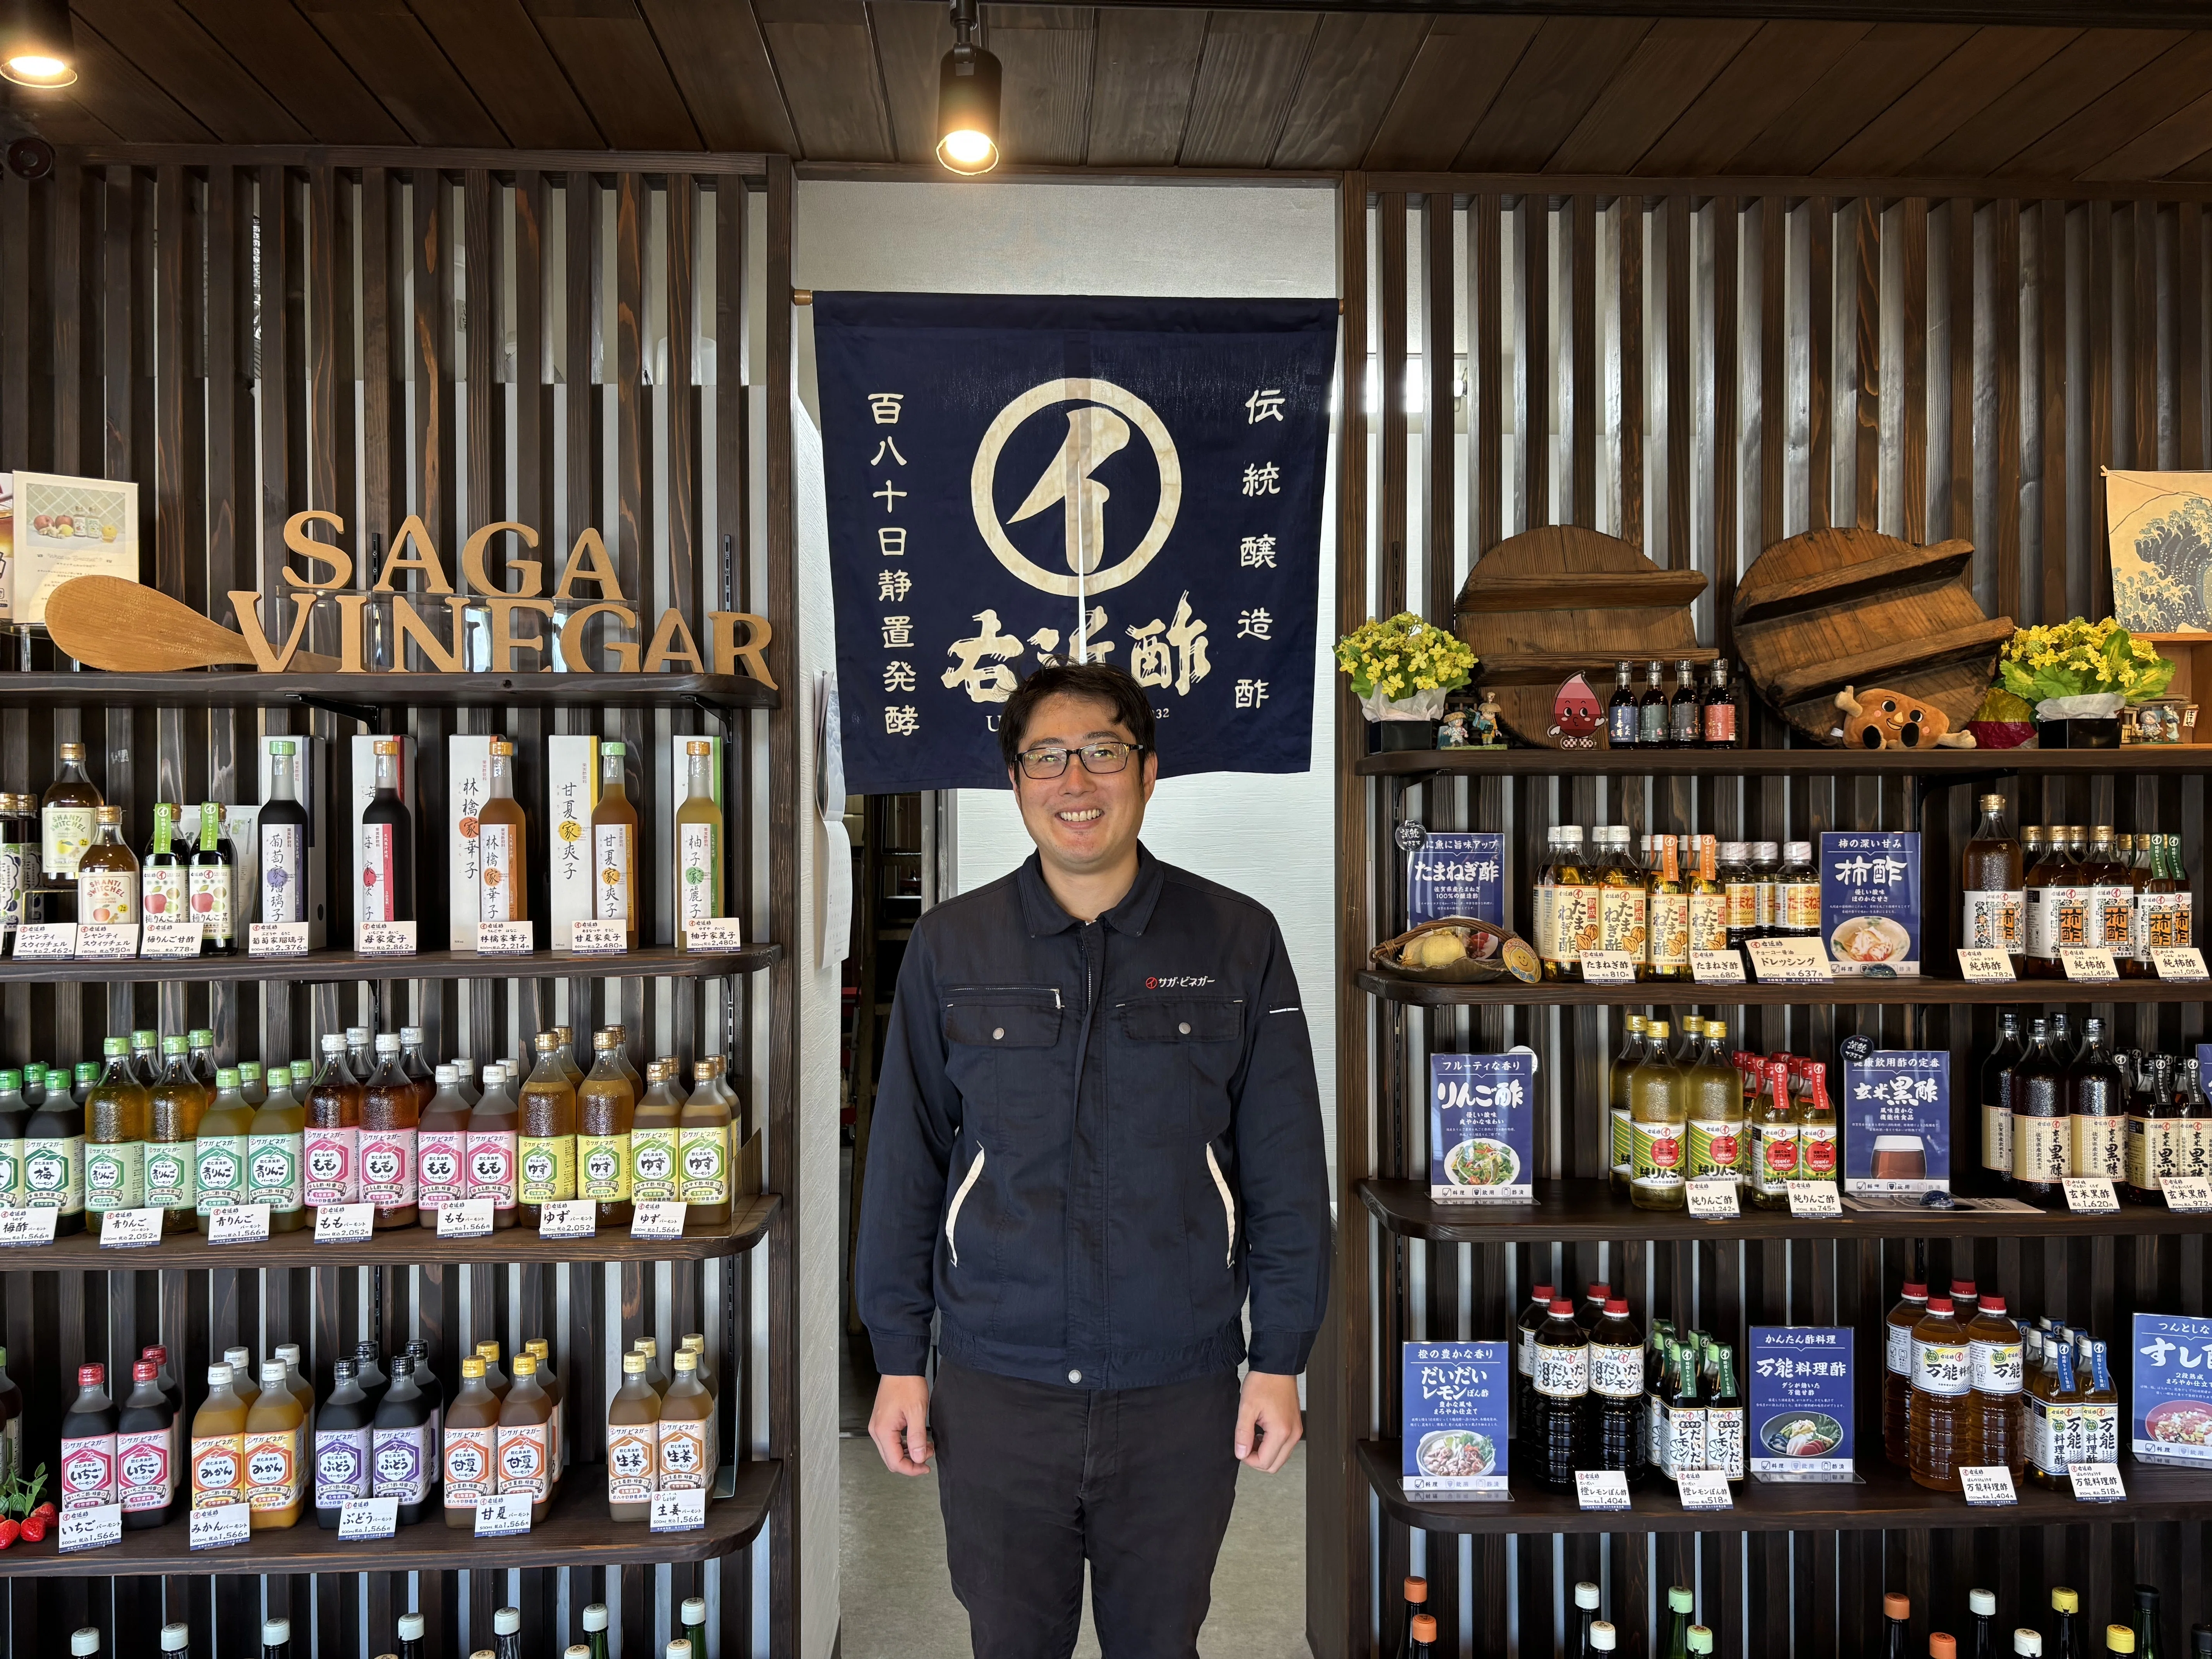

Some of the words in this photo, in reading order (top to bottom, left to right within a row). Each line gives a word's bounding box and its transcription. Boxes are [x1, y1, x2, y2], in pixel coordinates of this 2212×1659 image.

[282, 510, 624, 600] SAGA
[1235, 389, 1286, 709] 伝統醸造酢
[868, 393, 919, 737] 百八十日静置発酵
[228, 590, 778, 691] VINEGAR
[52, 814, 82, 823] SHANTI
[50, 821, 86, 833] SWITCHEL
[561, 782, 577, 880] 甘夏家爽子
[1422, 839, 1498, 850] に魚に旨味アップ
[1838, 838, 1902, 849] 柿の深い甘み
[603, 834, 619, 918] 甘夏家爽子
[1414, 860, 1499, 883] たまねぎ酢
[1835, 855, 1907, 887] 柿酢
[89, 879, 121, 888] SHANTI
[87, 886, 124, 898] SWITCHEL
[1994, 909, 2013, 940] 柿酢
[2060, 909, 2082, 943] 柿酢
[2104, 908, 2128, 942] 柿酢
[1587, 961, 1628, 969] たまねぎ酢
[1697, 962, 1738, 970] たまねぎ酢
[1760, 957, 1815, 966] ドレッシング
[1970, 962, 2001, 970] 純柿酢
[2074, 960, 2106, 969] 純柿酢
[2163, 958, 2196, 967] 純柿酢
[1158, 976, 1215, 987] サガ・ビネガー
[1443, 1061, 1520, 1071] フルーティな香り
[1437, 1079, 1523, 1109] りんご酢
[1853, 1076, 1938, 1106] 玄米黒酢
[370, 1161, 393, 1173] もも
[427, 1162, 450, 1175] もも
[477, 1162, 501, 1175] もも
[591, 1161, 611, 1173] ゆず
[641, 1157, 665, 1171] ゆず
[689, 1157, 713, 1170] ゆず
[34, 1167, 55, 1180] 梅
[92, 1170, 116, 1180] 青りんご
[152, 1168, 176, 1180] 青りんご
[203, 1166, 233, 1180] 青りんご
[1692, 1195, 1732, 1205] 純りんご酢
[1793, 1194, 1834, 1204] 純りんご酢
[2069, 1190, 2110, 1199] 玄米黒酢
[2168, 1189, 2207, 1199] 玄米黒酢
[113, 1218, 147, 1228] 青りんご
[216, 1214, 253, 1226] 青りんご
[320, 1217, 343, 1228] もも
[445, 1212, 464, 1223] もも
[544, 1210, 570, 1224] ゆず
[641, 1214, 660, 1224] ゆず
[3, 1222, 28, 1233] 梅酢
[1765, 1334, 1836, 1345] かんたん酢料理
[1418, 1349, 1492, 1359] 橙の豊かな香り
[1755, 1358, 1847, 1378] 万能料理酢
[1421, 1366, 1487, 1385] だいだい
[1423, 1385, 1468, 1401] レモン
[507, 1455, 534, 1469] 甘夏
[617, 1453, 642, 1467] 生姜
[667, 1449, 693, 1463] 生姜
[126, 1463, 159, 1475] いちご
[252, 1463, 283, 1475] みかん
[323, 1462, 350, 1472] ぶどう
[380, 1459, 408, 1471] ぶどう
[451, 1459, 477, 1473] 甘夏
[70, 1468, 101, 1481] いちご
[201, 1467, 232, 1479] みかん
[1967, 1483, 2007, 1491] 万能料理酢
[2076, 1477, 2117, 1486] 万能料理酢
[1580, 1486, 1626, 1496] 橙レモンぽん酢
[1683, 1487, 1727, 1496] 橙レモンぽん酢
[481, 1506, 507, 1520] 甘夏
[658, 1503, 680, 1516] 生姜
[343, 1512, 372, 1524] ぶどう
[62, 1520, 95, 1535] いちご
[192, 1522, 223, 1533] みかん
